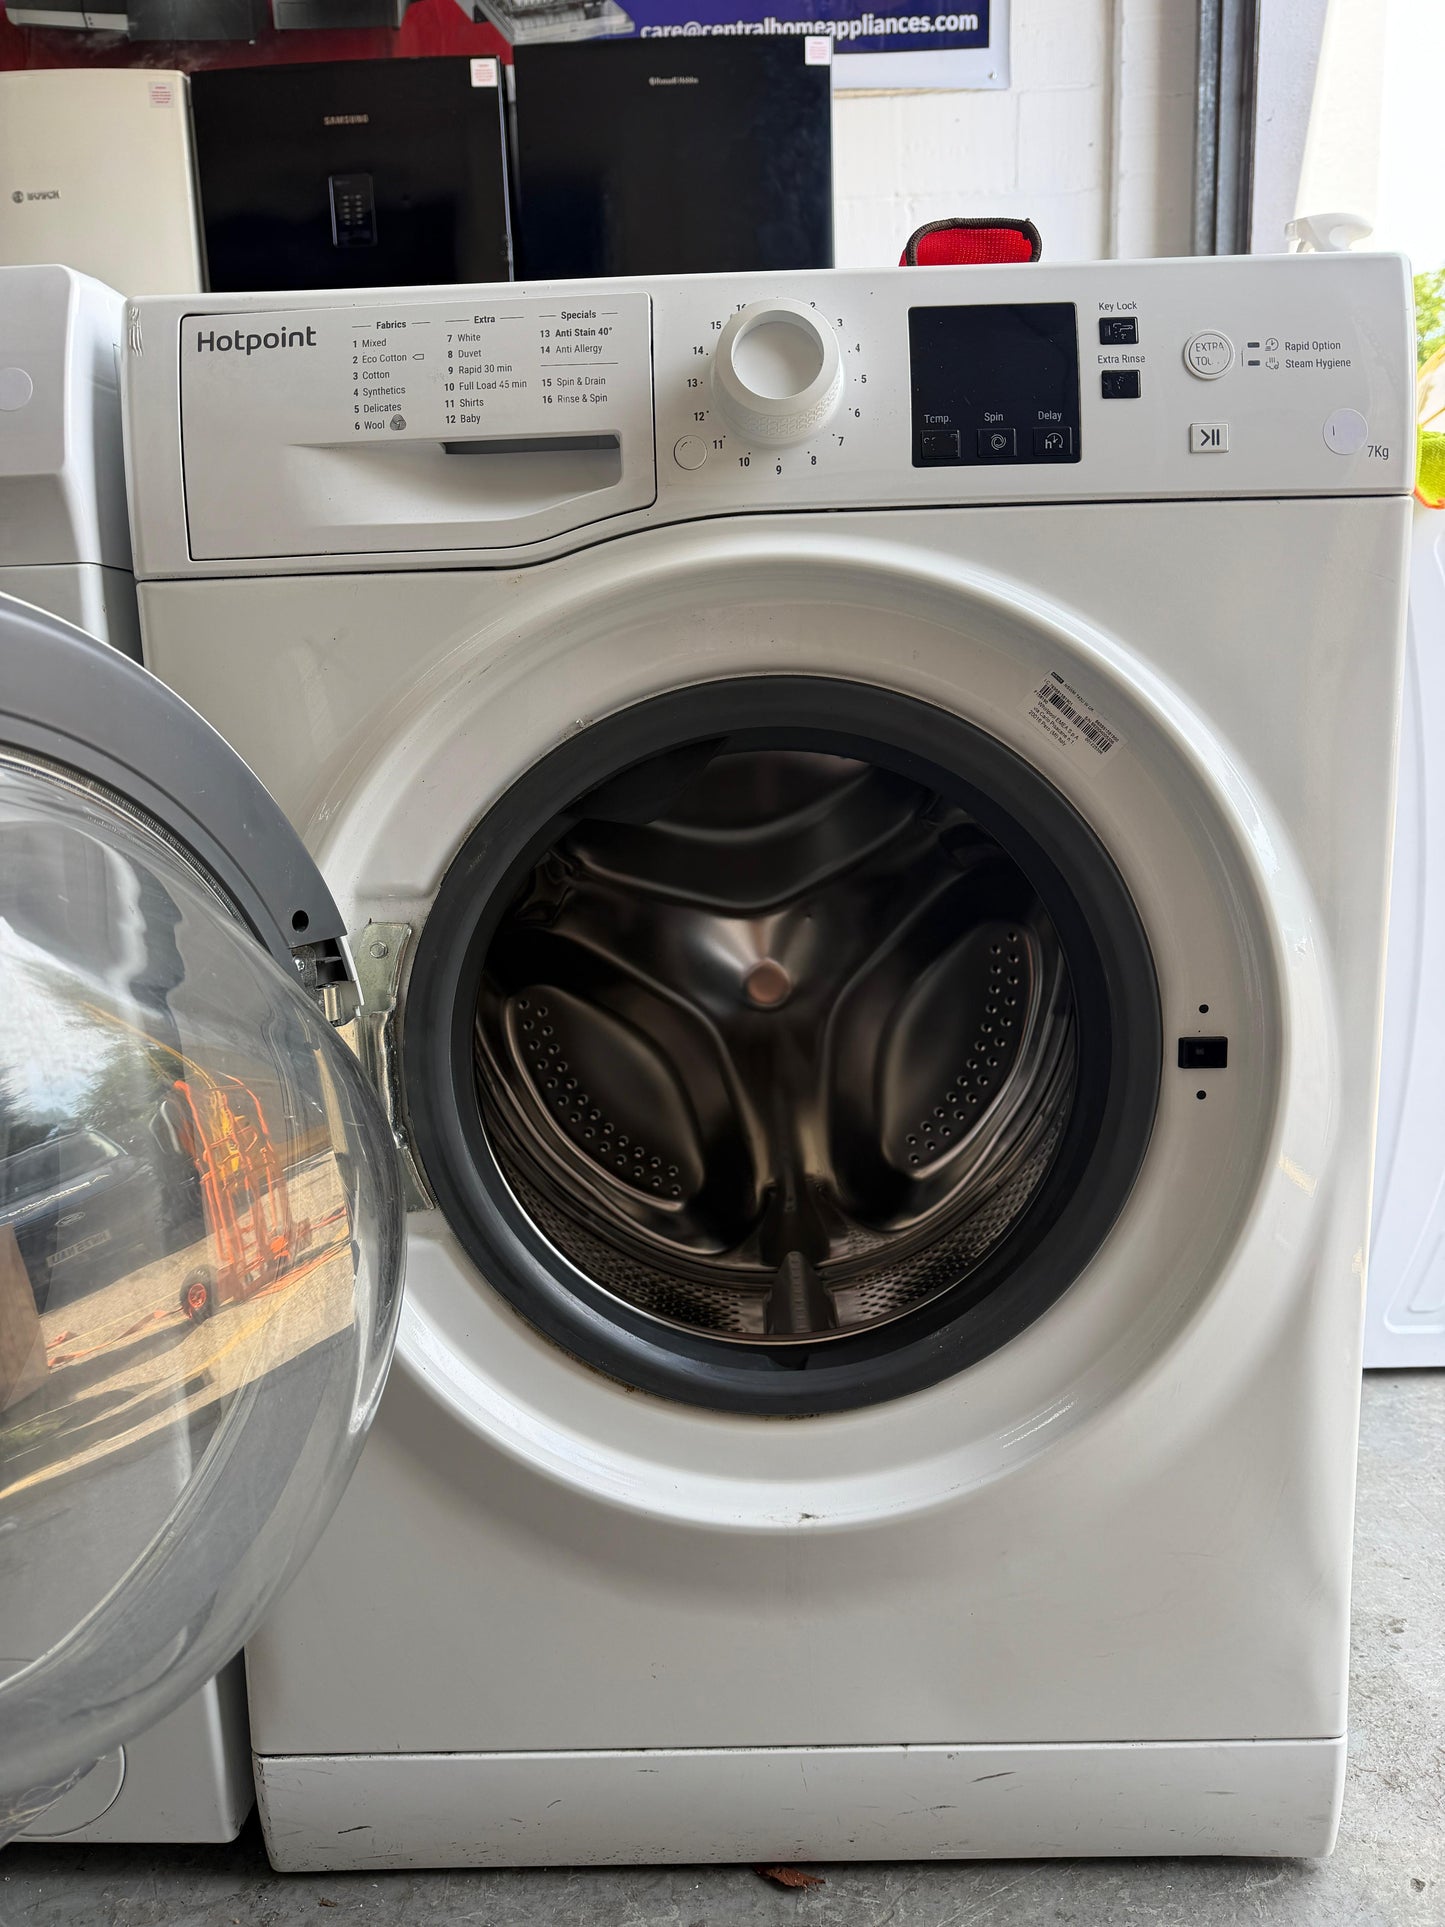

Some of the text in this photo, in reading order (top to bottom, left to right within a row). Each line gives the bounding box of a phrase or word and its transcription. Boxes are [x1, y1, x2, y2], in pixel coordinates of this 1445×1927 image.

[1098, 301, 1138, 312] Key Lock
[474, 315, 496, 324] Extra
[560, 309, 597, 321] Specials
[376, 320, 407, 330] Fabrics
[710, 321, 722, 330] 15
[837, 318, 843, 327] 3
[447, 333, 481, 343] 7 White
[540, 329, 550, 338] 13
[555, 328, 572, 337] Anti
[574, 328, 596, 336] Stain
[197, 326, 317, 356] Hotpoint
[352, 338, 387, 349] 1 Mixed
[1284, 341, 1341, 352] Rapid Option
[540, 343, 603, 355] 14 Anti Allergy
[692, 345, 704, 355] 14
[855, 343, 861, 353] 4
[1195, 342, 1225, 352] EXTRA
[352, 353, 407, 365] 2 Eco Cotton
[447, 349, 482, 359] 8 Duvet
[1097, 354, 1146, 364] Extra Rinse
[448, 363, 513, 376] 9 Rapid 30 min
[1285, 359, 1352, 369] Steam Hygiene
[352, 370, 390, 381] 3 Cotton
[861, 374, 867, 384] 5
[444, 379, 527, 392] 10 Full Load 45 min
[542, 375, 606, 388] 15 Spin & Drain
[687, 378, 698, 388] 13
[353, 385, 406, 398] 4 Synthetics
[445, 398, 484, 409] 11 Shirts
[542, 393, 608, 404] 16 Rinse & Spin
[354, 402, 402, 414] 5 Delicates
[854, 408, 861, 418] 6
[446, 413, 481, 424] 12 Baby
[693, 411, 705, 421] 12
[924, 414, 951, 425] Temp.
[984, 411, 1004, 423] Spin
[1038, 410, 1063, 422] Delay
[354, 419, 385, 431] 6 Wool
[713, 439, 723, 450] 11
[837, 436, 845, 446] 7
[1367, 445, 1390, 460] 7Kg
[738, 457, 750, 467] 10
[810, 455, 817, 466] 8
[775, 465, 782, 475] 9
